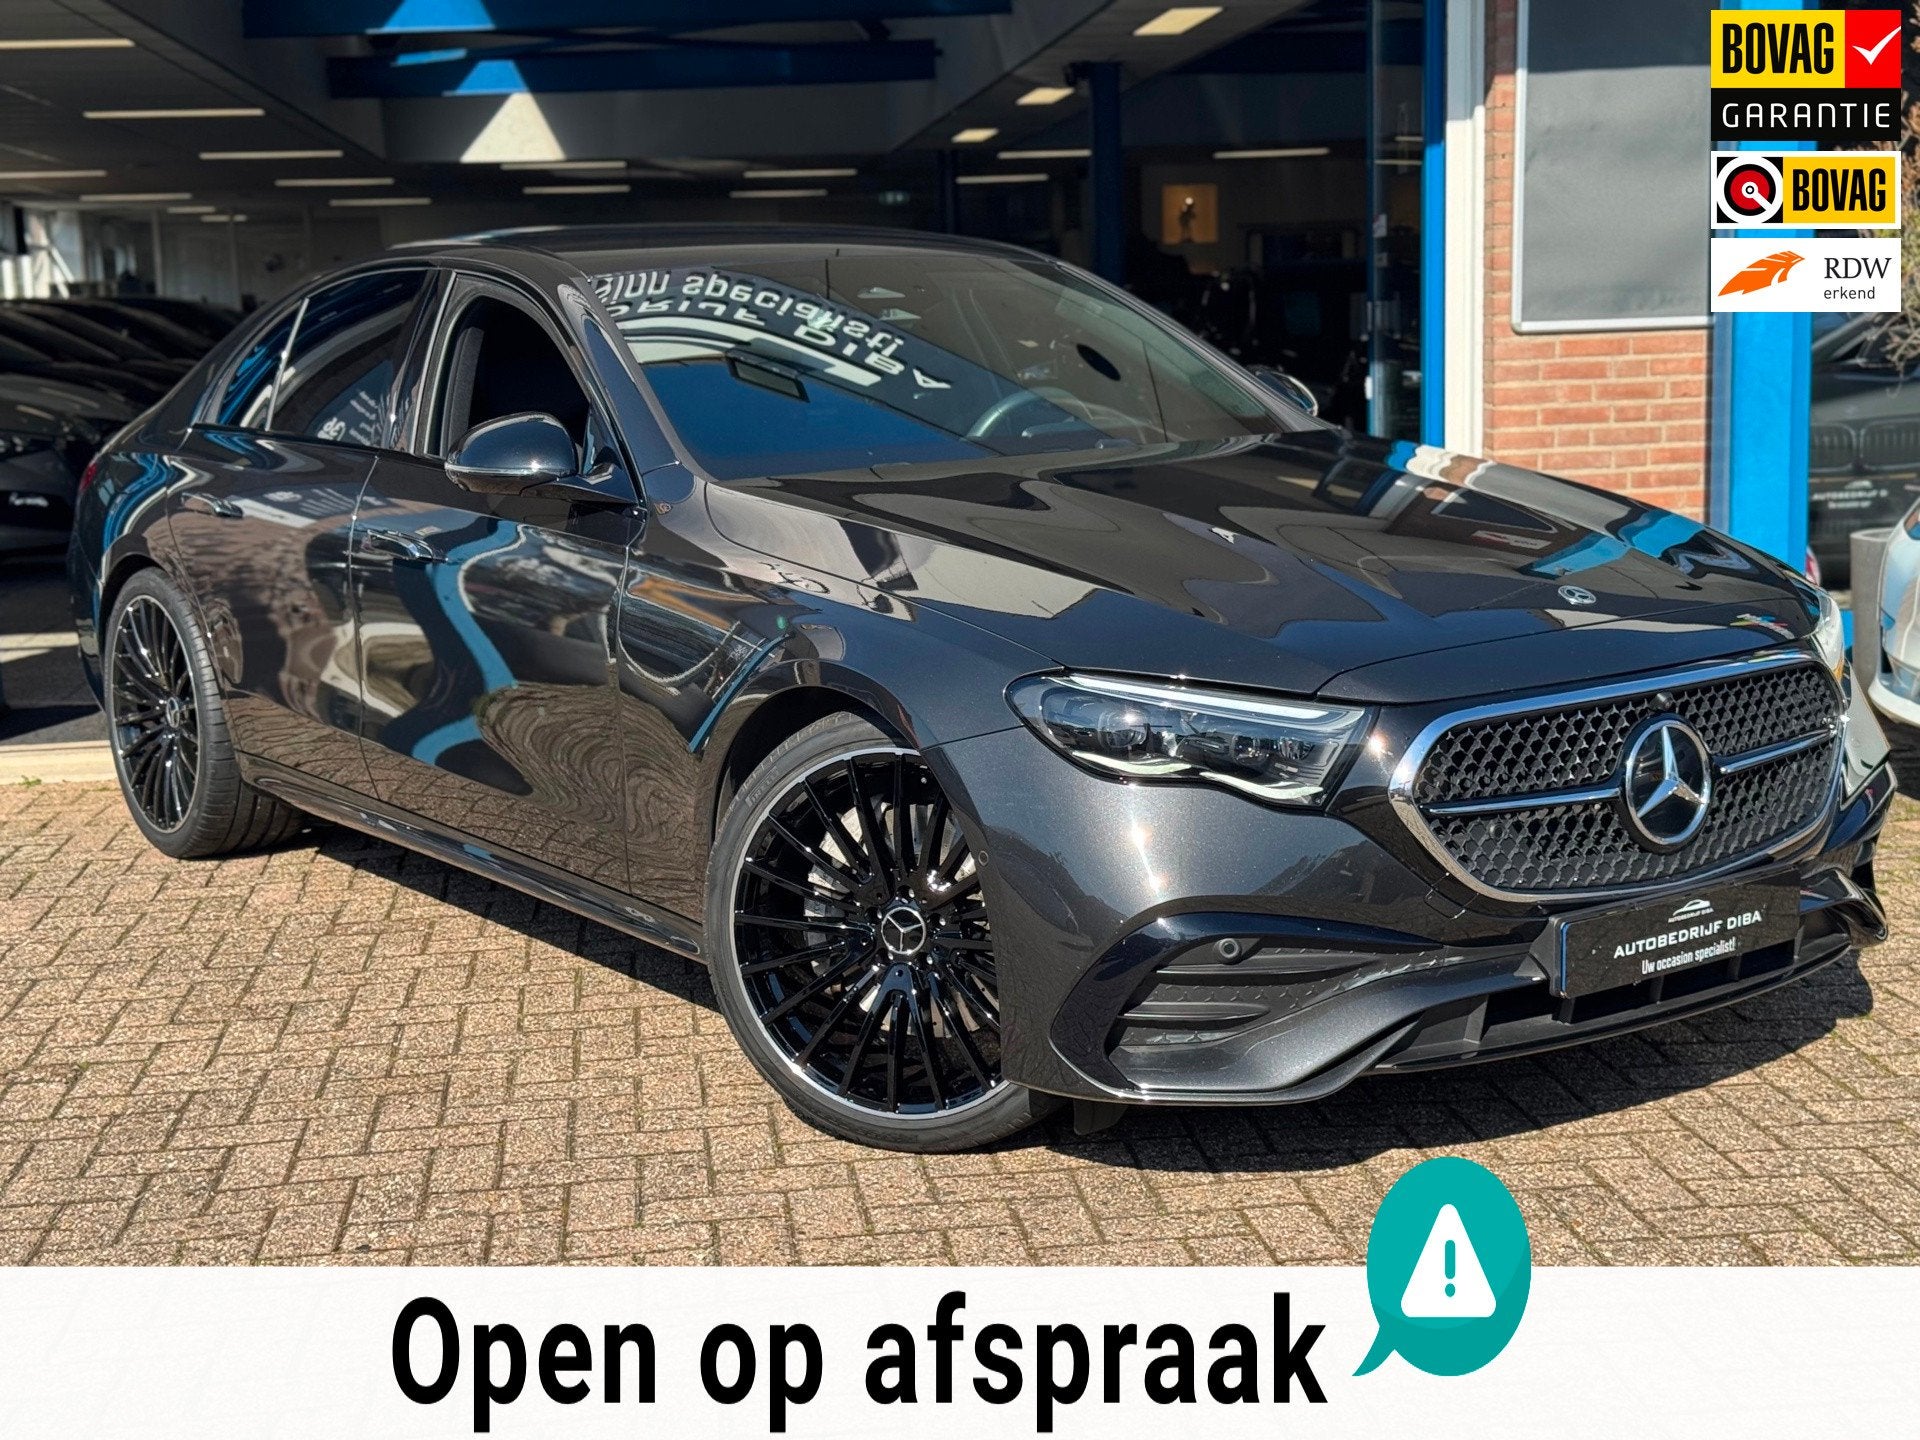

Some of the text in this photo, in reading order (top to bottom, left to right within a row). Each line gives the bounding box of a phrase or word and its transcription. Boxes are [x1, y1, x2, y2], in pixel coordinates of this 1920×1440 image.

[1613, 910, 1762, 958] AUTOBEDRIJF DIBA
[1642, 936, 1736, 975] Uw occasion specialist!
